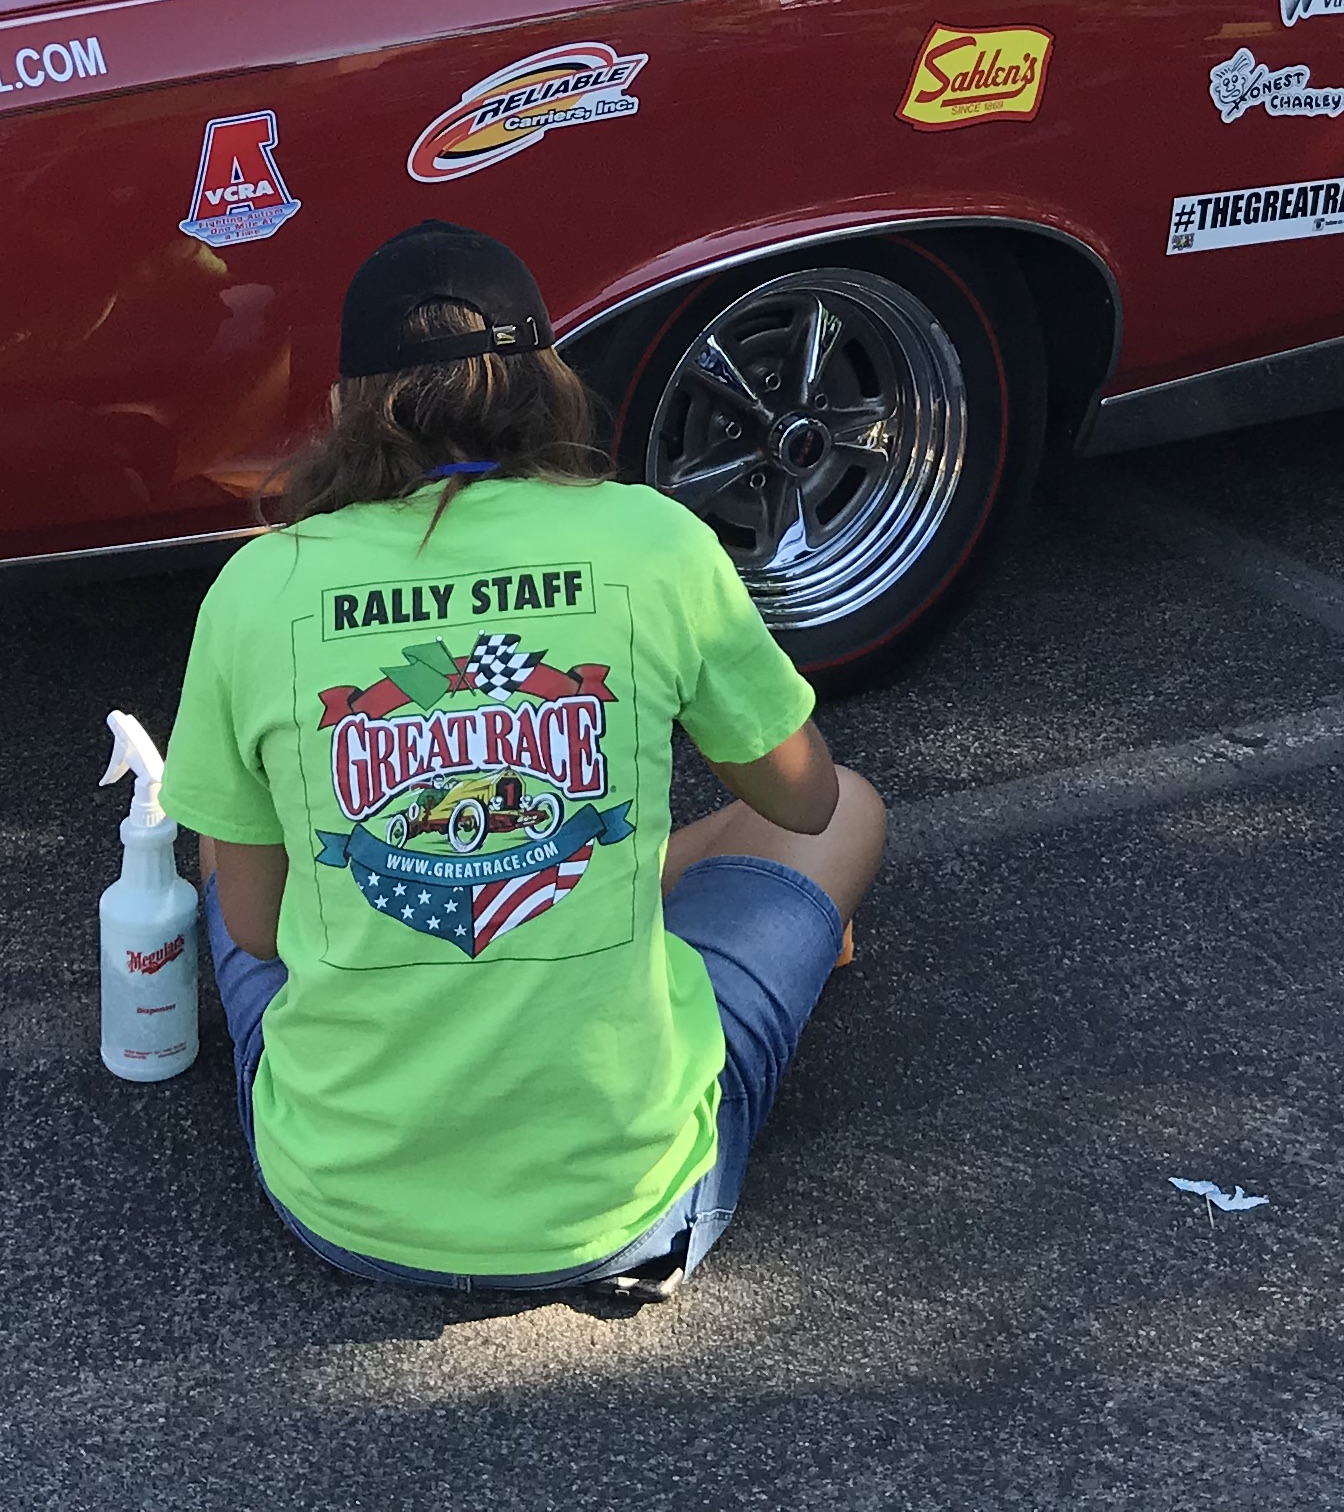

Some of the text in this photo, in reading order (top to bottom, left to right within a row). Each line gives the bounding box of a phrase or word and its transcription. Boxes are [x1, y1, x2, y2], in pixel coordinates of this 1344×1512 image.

[915, 36, 1038, 104] Sahlen's
[476, 63, 633, 126] RELIABLE
[951, 102, 981, 116] SINCE
[1270, 94, 1342, 110] CHARLEY
[504, 100, 634, 131] Carriers, Inc.
[204, 180, 275, 205] VCRA
[199, 208, 284, 230] Fighting Autism
[333, 569, 585, 632] RALLY STAFF
[335, 699, 603, 819] GREAT RACE
[385, 840, 559, 880] WWW.GREATRACE.COM
